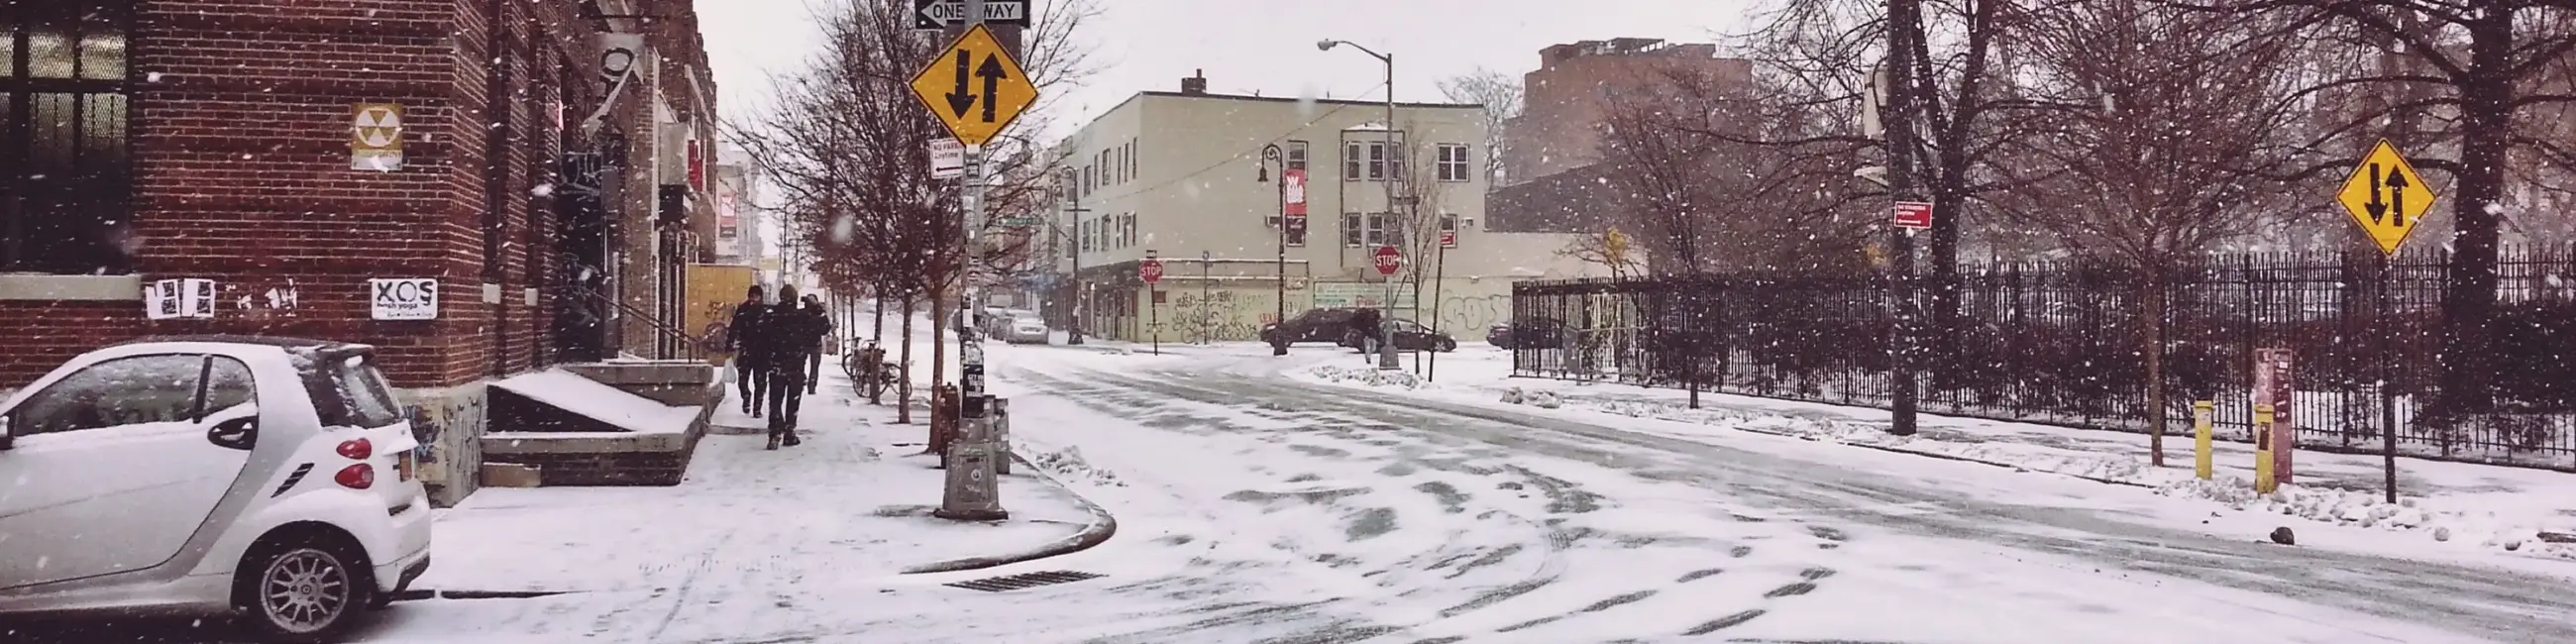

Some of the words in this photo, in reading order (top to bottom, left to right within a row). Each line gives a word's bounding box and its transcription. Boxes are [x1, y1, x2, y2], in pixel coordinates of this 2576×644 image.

[932, 3, 965, 19] ONE
[1376, 255, 1399, 267] STOP
[1140, 266, 1162, 276] STOP
[376, 280, 434, 306] XOS
